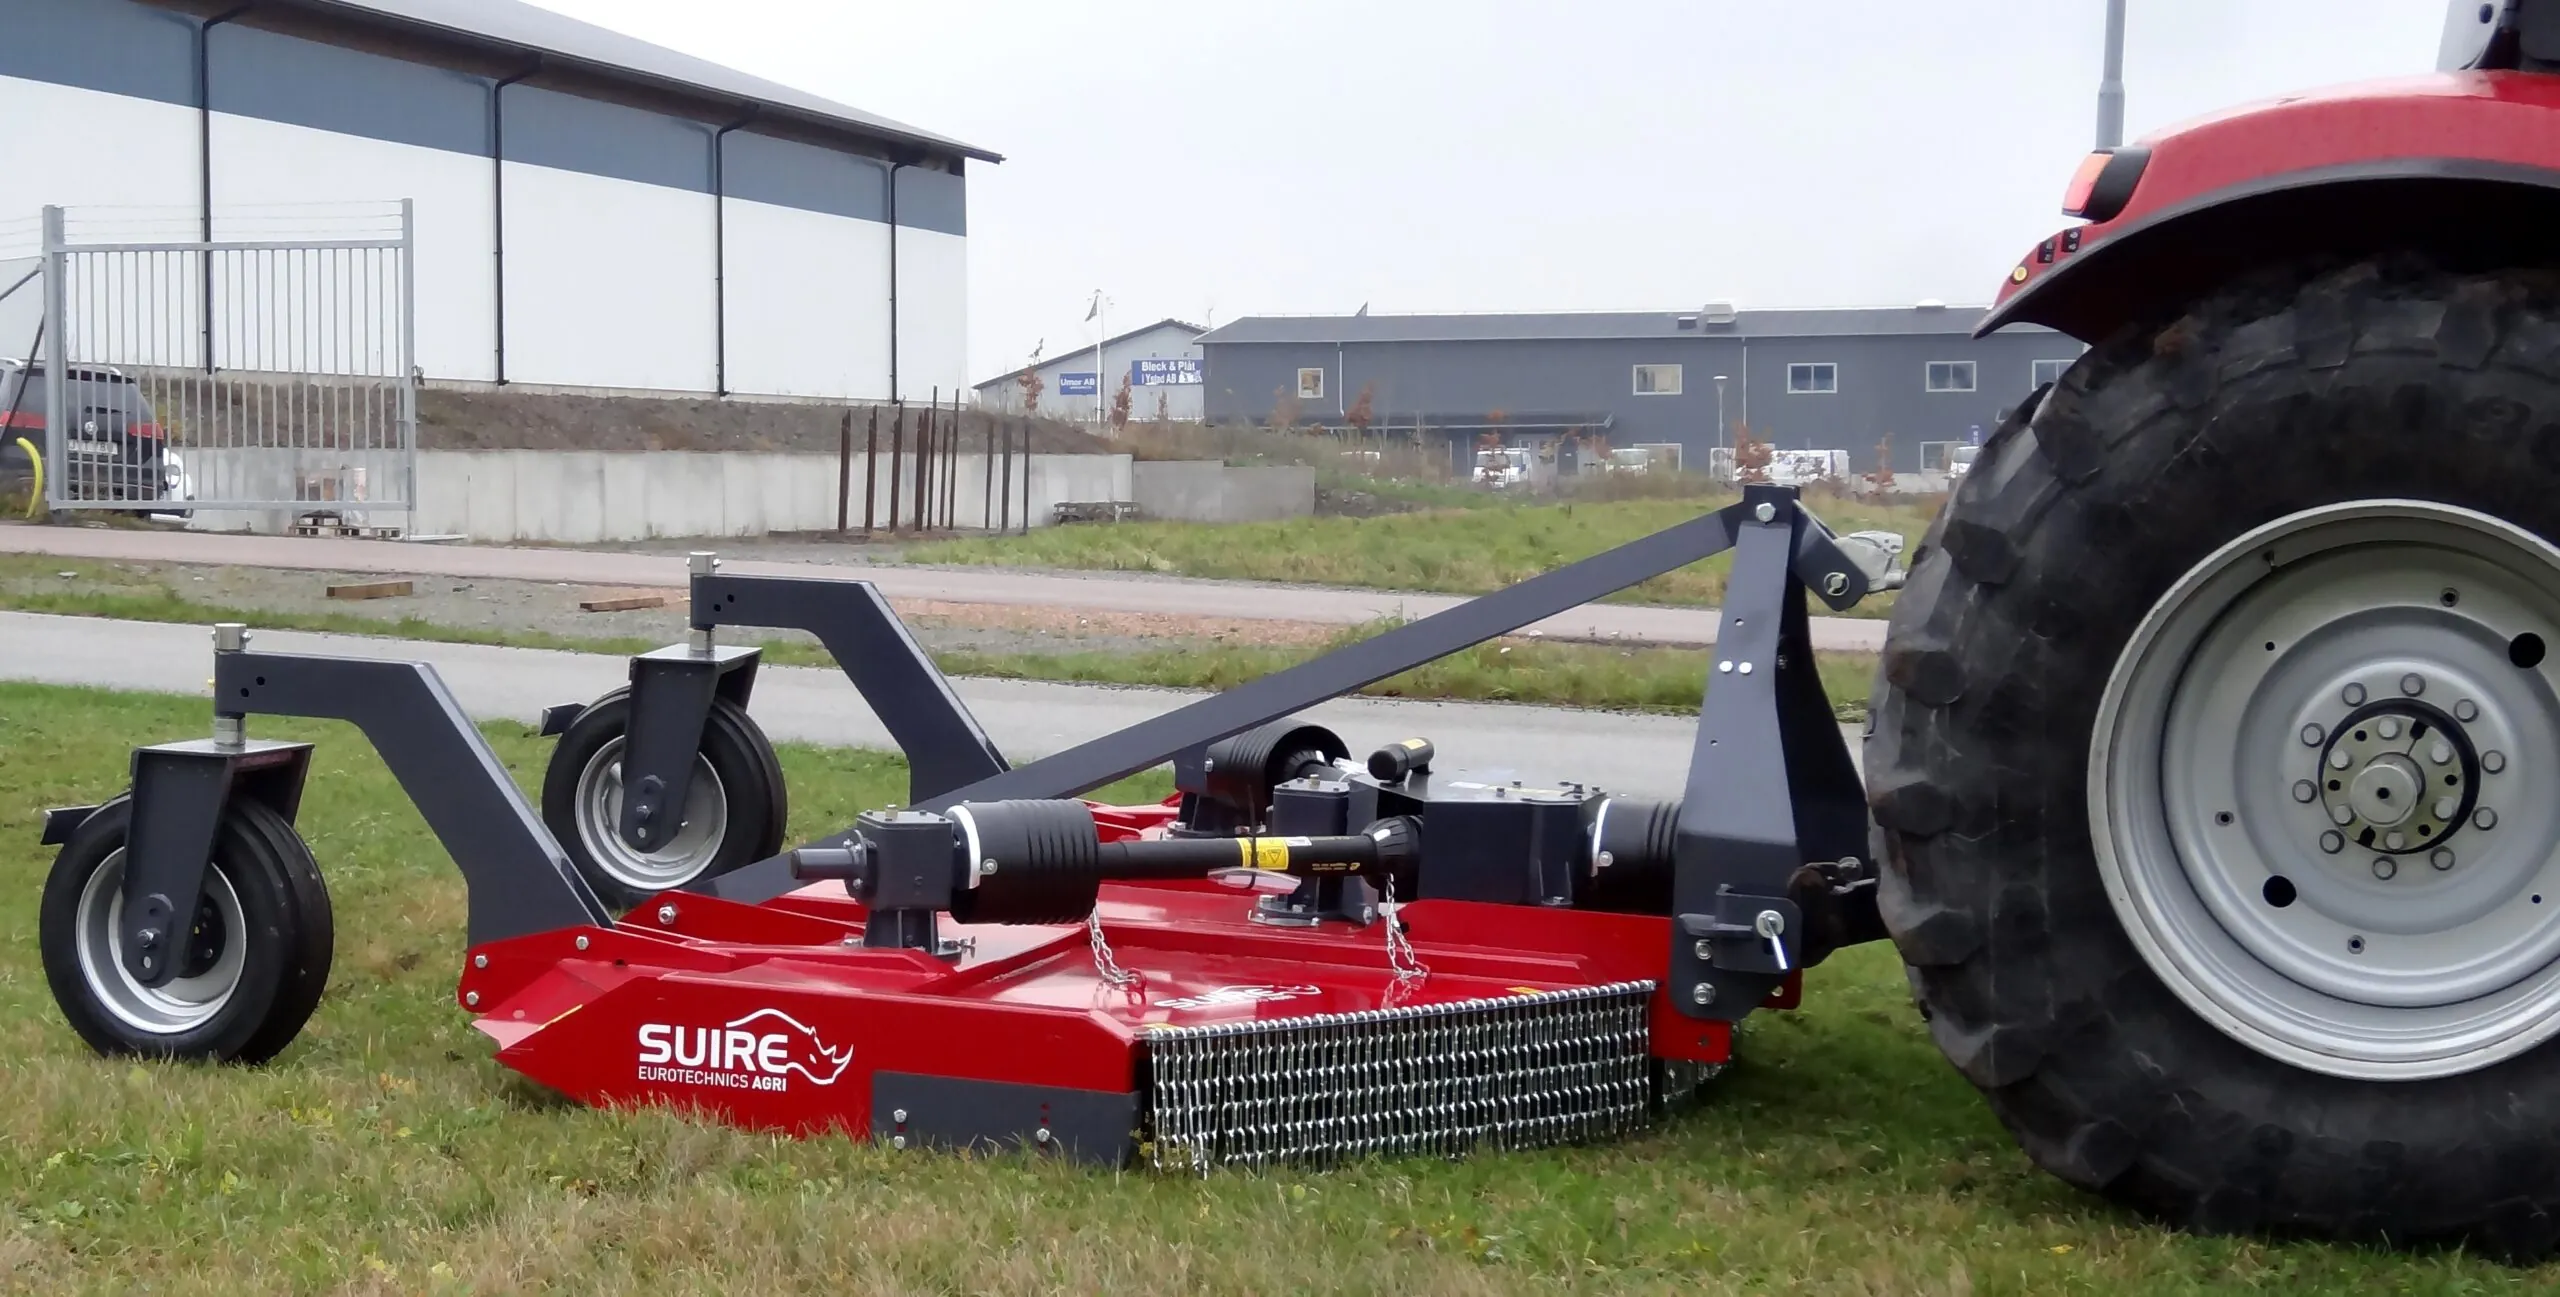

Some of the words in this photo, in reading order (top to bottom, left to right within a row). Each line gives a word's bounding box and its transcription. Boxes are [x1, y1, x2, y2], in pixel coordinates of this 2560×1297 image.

[1169, 361, 1176, 371] &
[1083, 378, 1095, 386] AB
[1166, 373, 1177, 384] AB
[638, 1024, 788, 1074] SUIRE
[638, 1066, 749, 1088] EUROTECHNICS
[752, 1076, 787, 1092] AGRI
